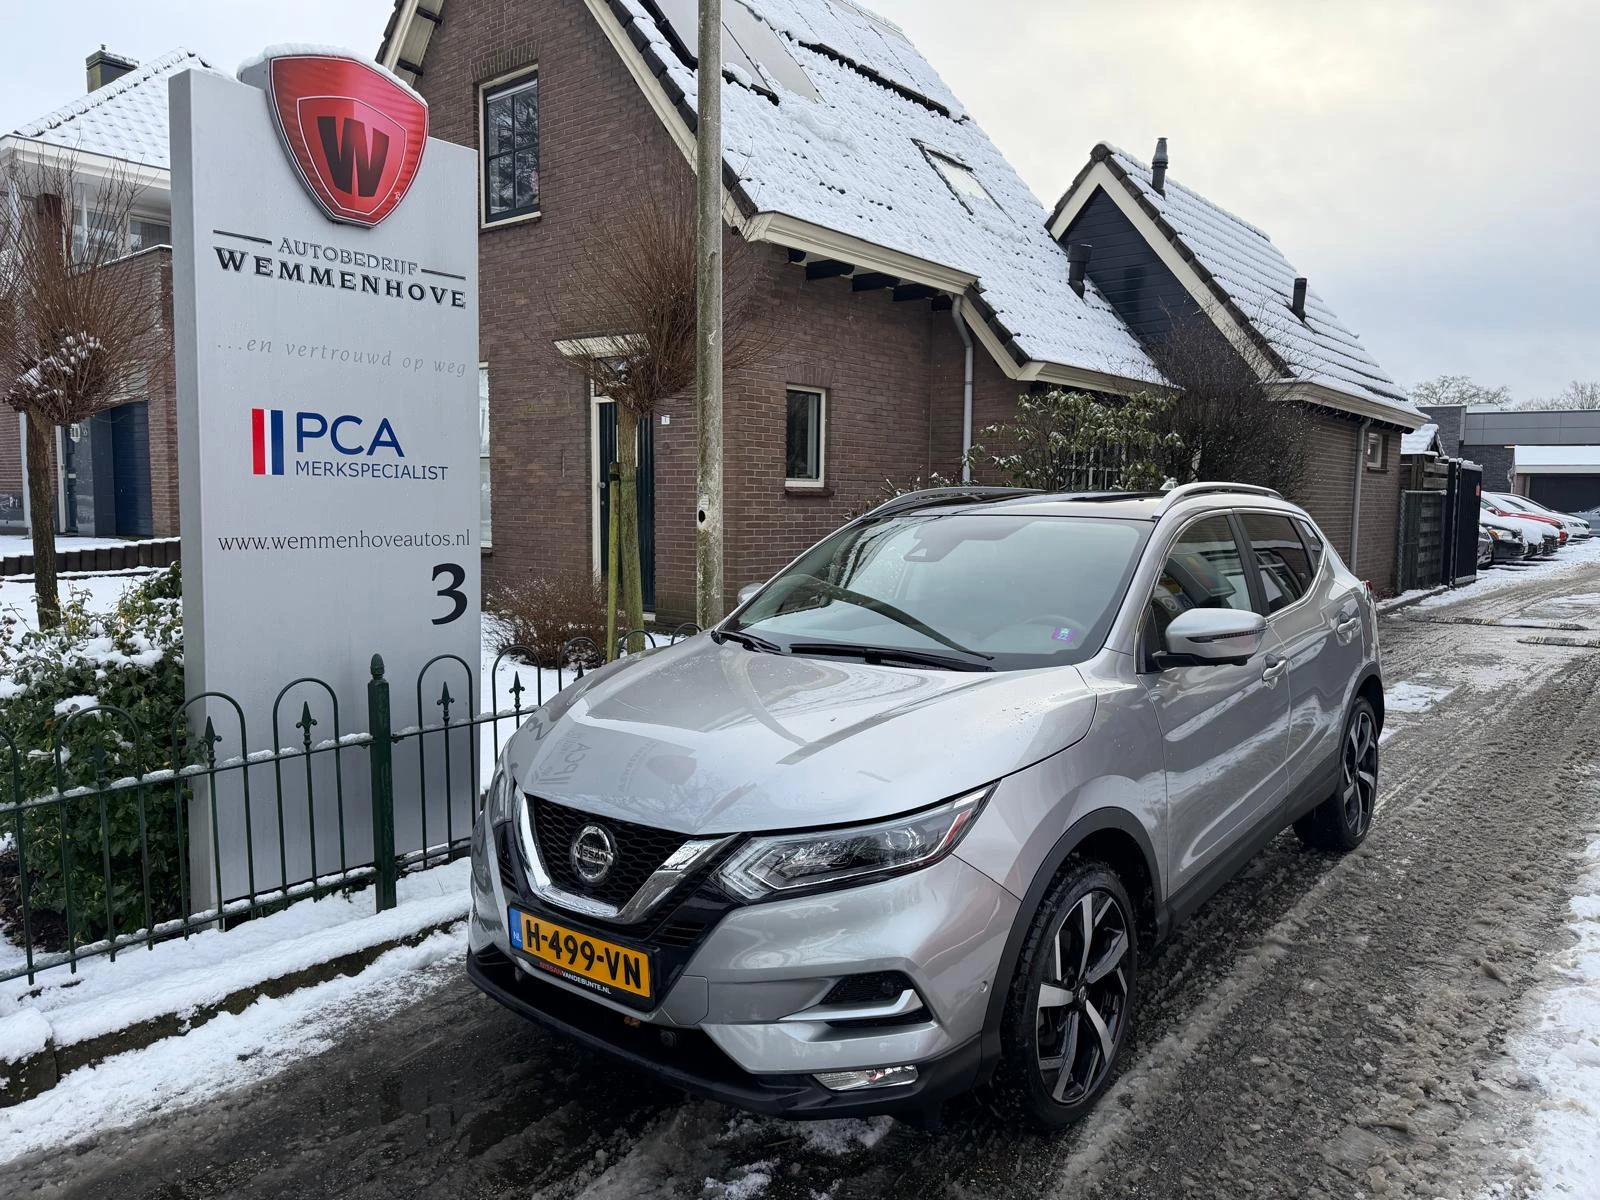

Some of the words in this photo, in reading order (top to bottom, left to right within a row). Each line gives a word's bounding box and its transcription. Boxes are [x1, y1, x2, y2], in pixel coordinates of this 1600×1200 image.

[317, 115, 390, 197] W
[277, 236, 418, 275] AUTOBEDRIJF
[213, 246, 466, 308] WEMMENHOVE
[285, 342, 392, 367] vertrouwd
[402, 357, 424, 372] op
[434, 361, 466, 378] weg
[296, 411, 405, 458] PCA
[295, 460, 449, 481] MERKSPECIALIST
[218, 529, 471, 551] www.wemmenhoveautos.nl
[431, 563, 468, 625] 3
[575, 843, 608, 863] NISSAN
[513, 930, 522, 943] NL
[525, 919, 642, 990] H-499-VN
